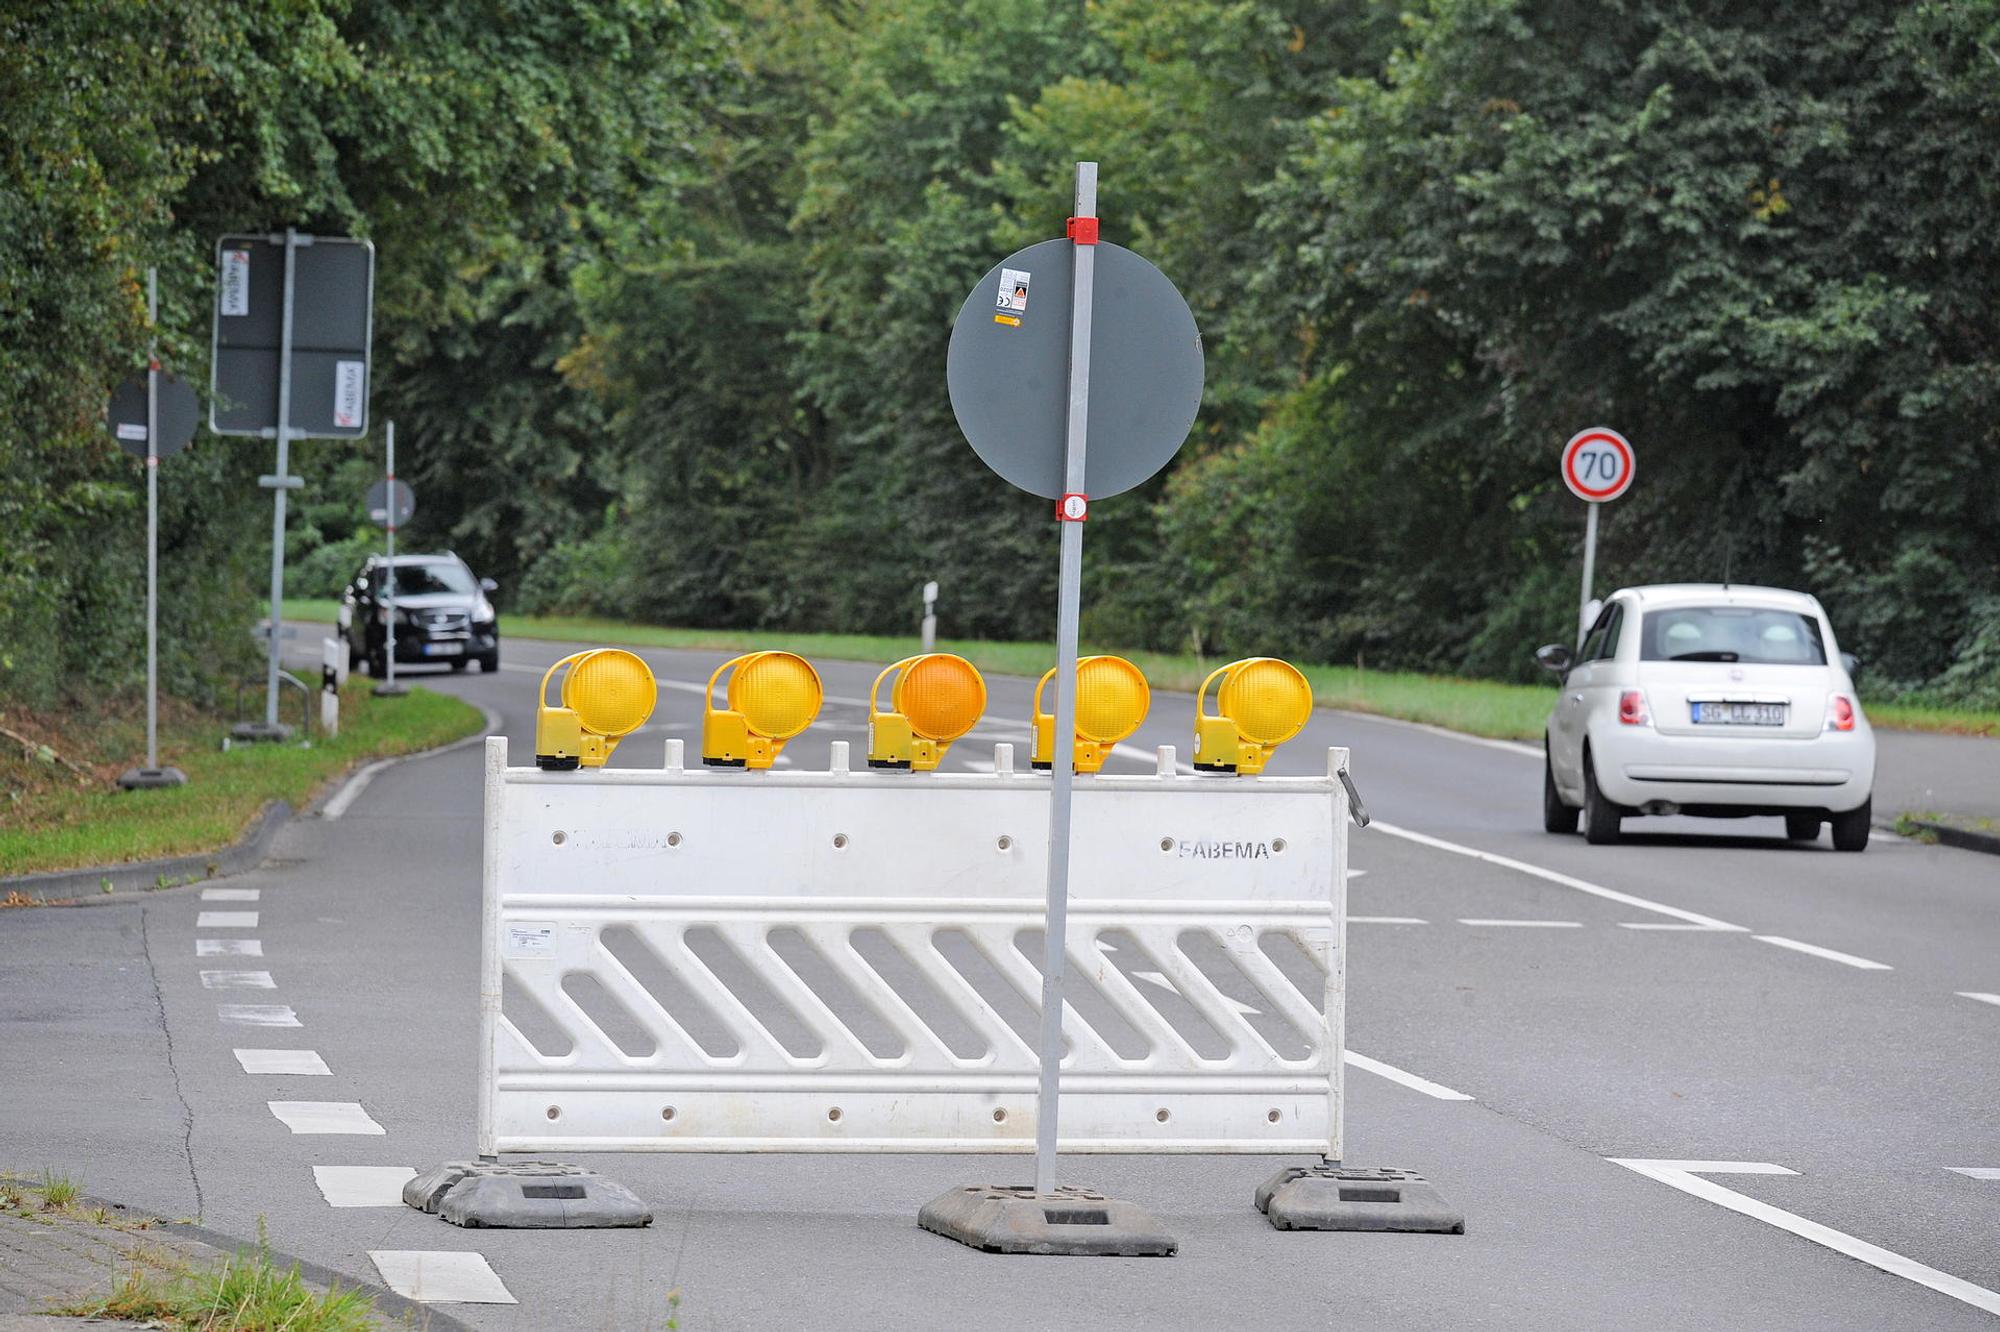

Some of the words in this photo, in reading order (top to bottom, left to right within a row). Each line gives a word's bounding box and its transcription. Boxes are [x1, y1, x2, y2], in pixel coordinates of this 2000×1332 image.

[1582, 452, 1616, 480] 70
[1702, 703, 1722, 720] SG
[1179, 841, 1269, 859] FABEMA
